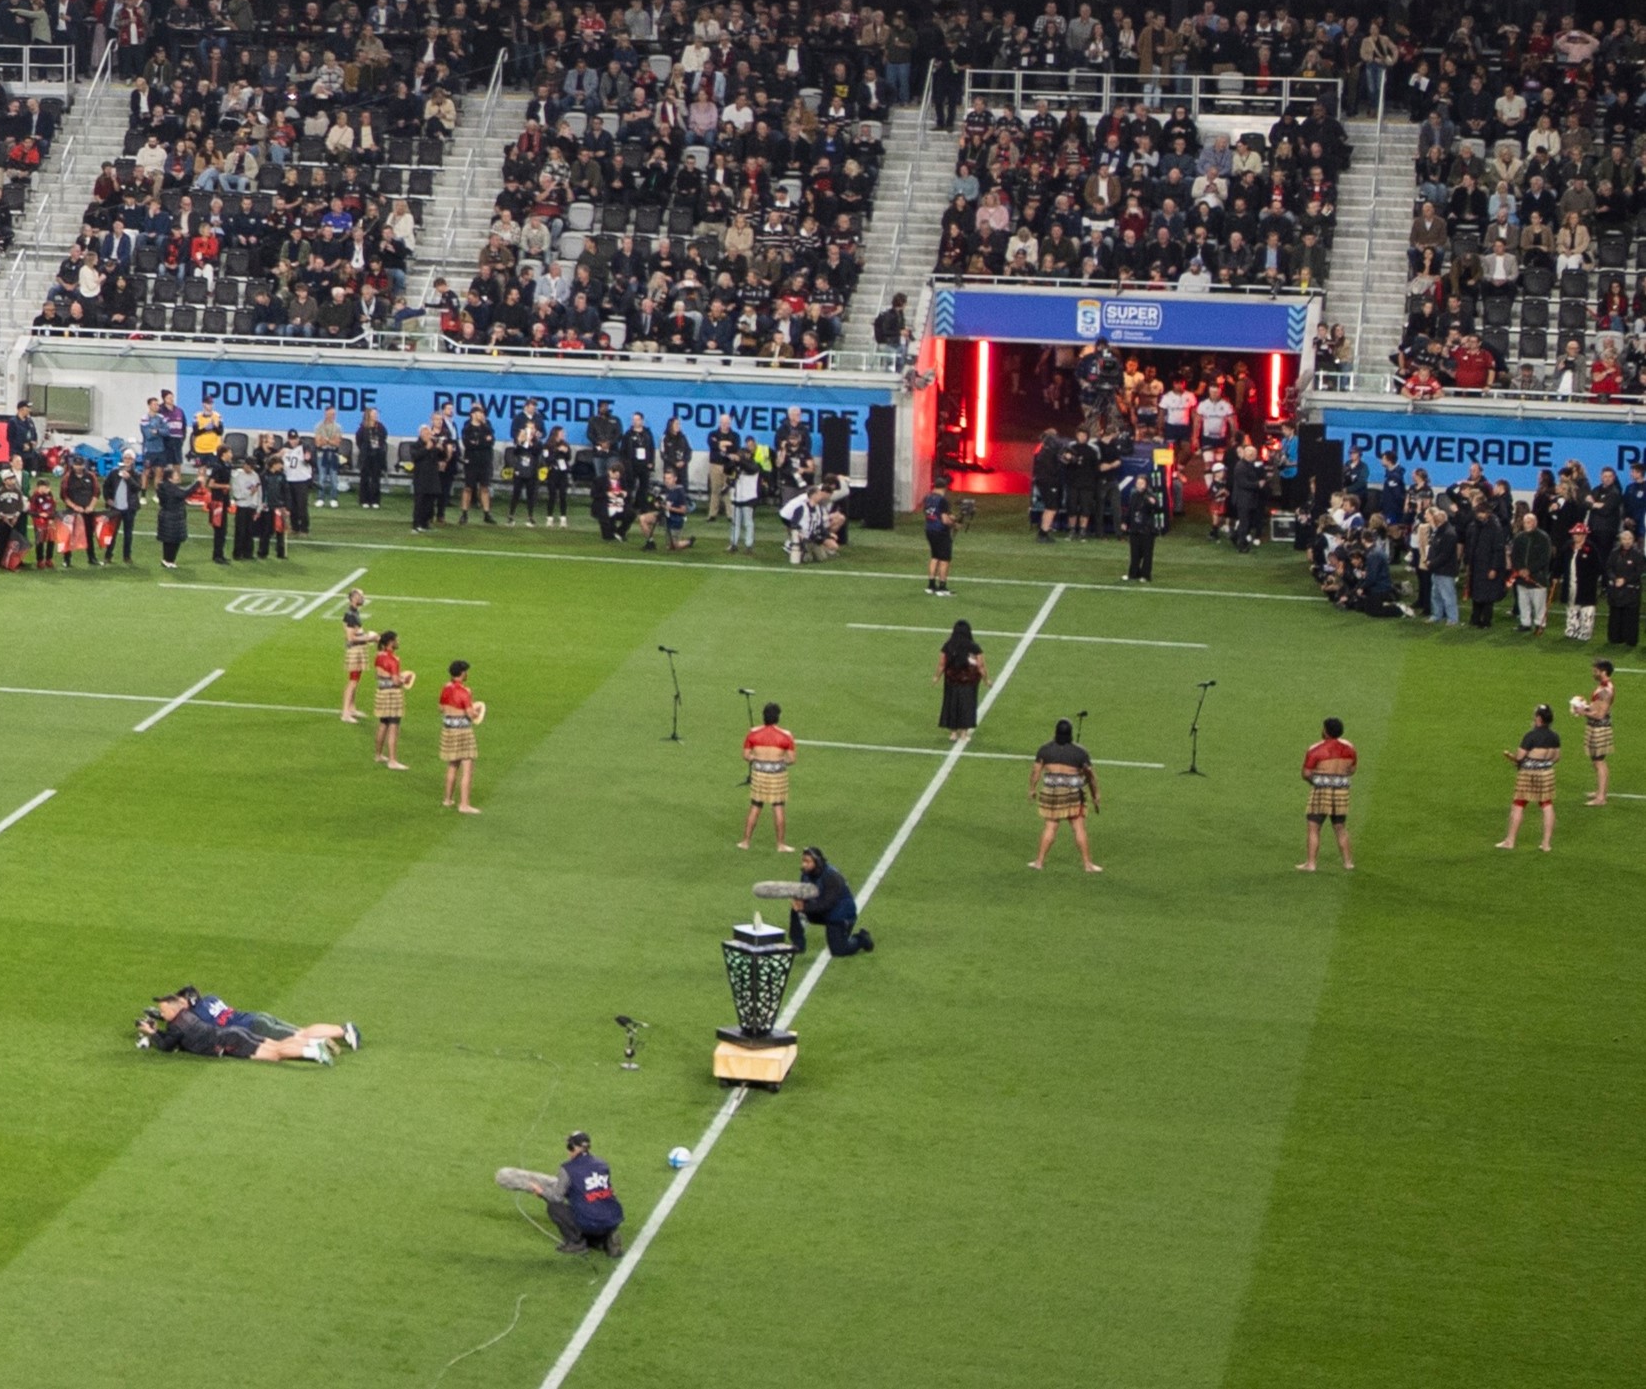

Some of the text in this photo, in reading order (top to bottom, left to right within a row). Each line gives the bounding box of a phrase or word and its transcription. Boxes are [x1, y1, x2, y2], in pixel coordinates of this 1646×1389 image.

[1106, 305, 1158, 320] SUPER
[202, 381, 378, 413] POWERADE
[1351, 432, 1553, 468] POWERADE
[585, 1172, 609, 1190] sky
